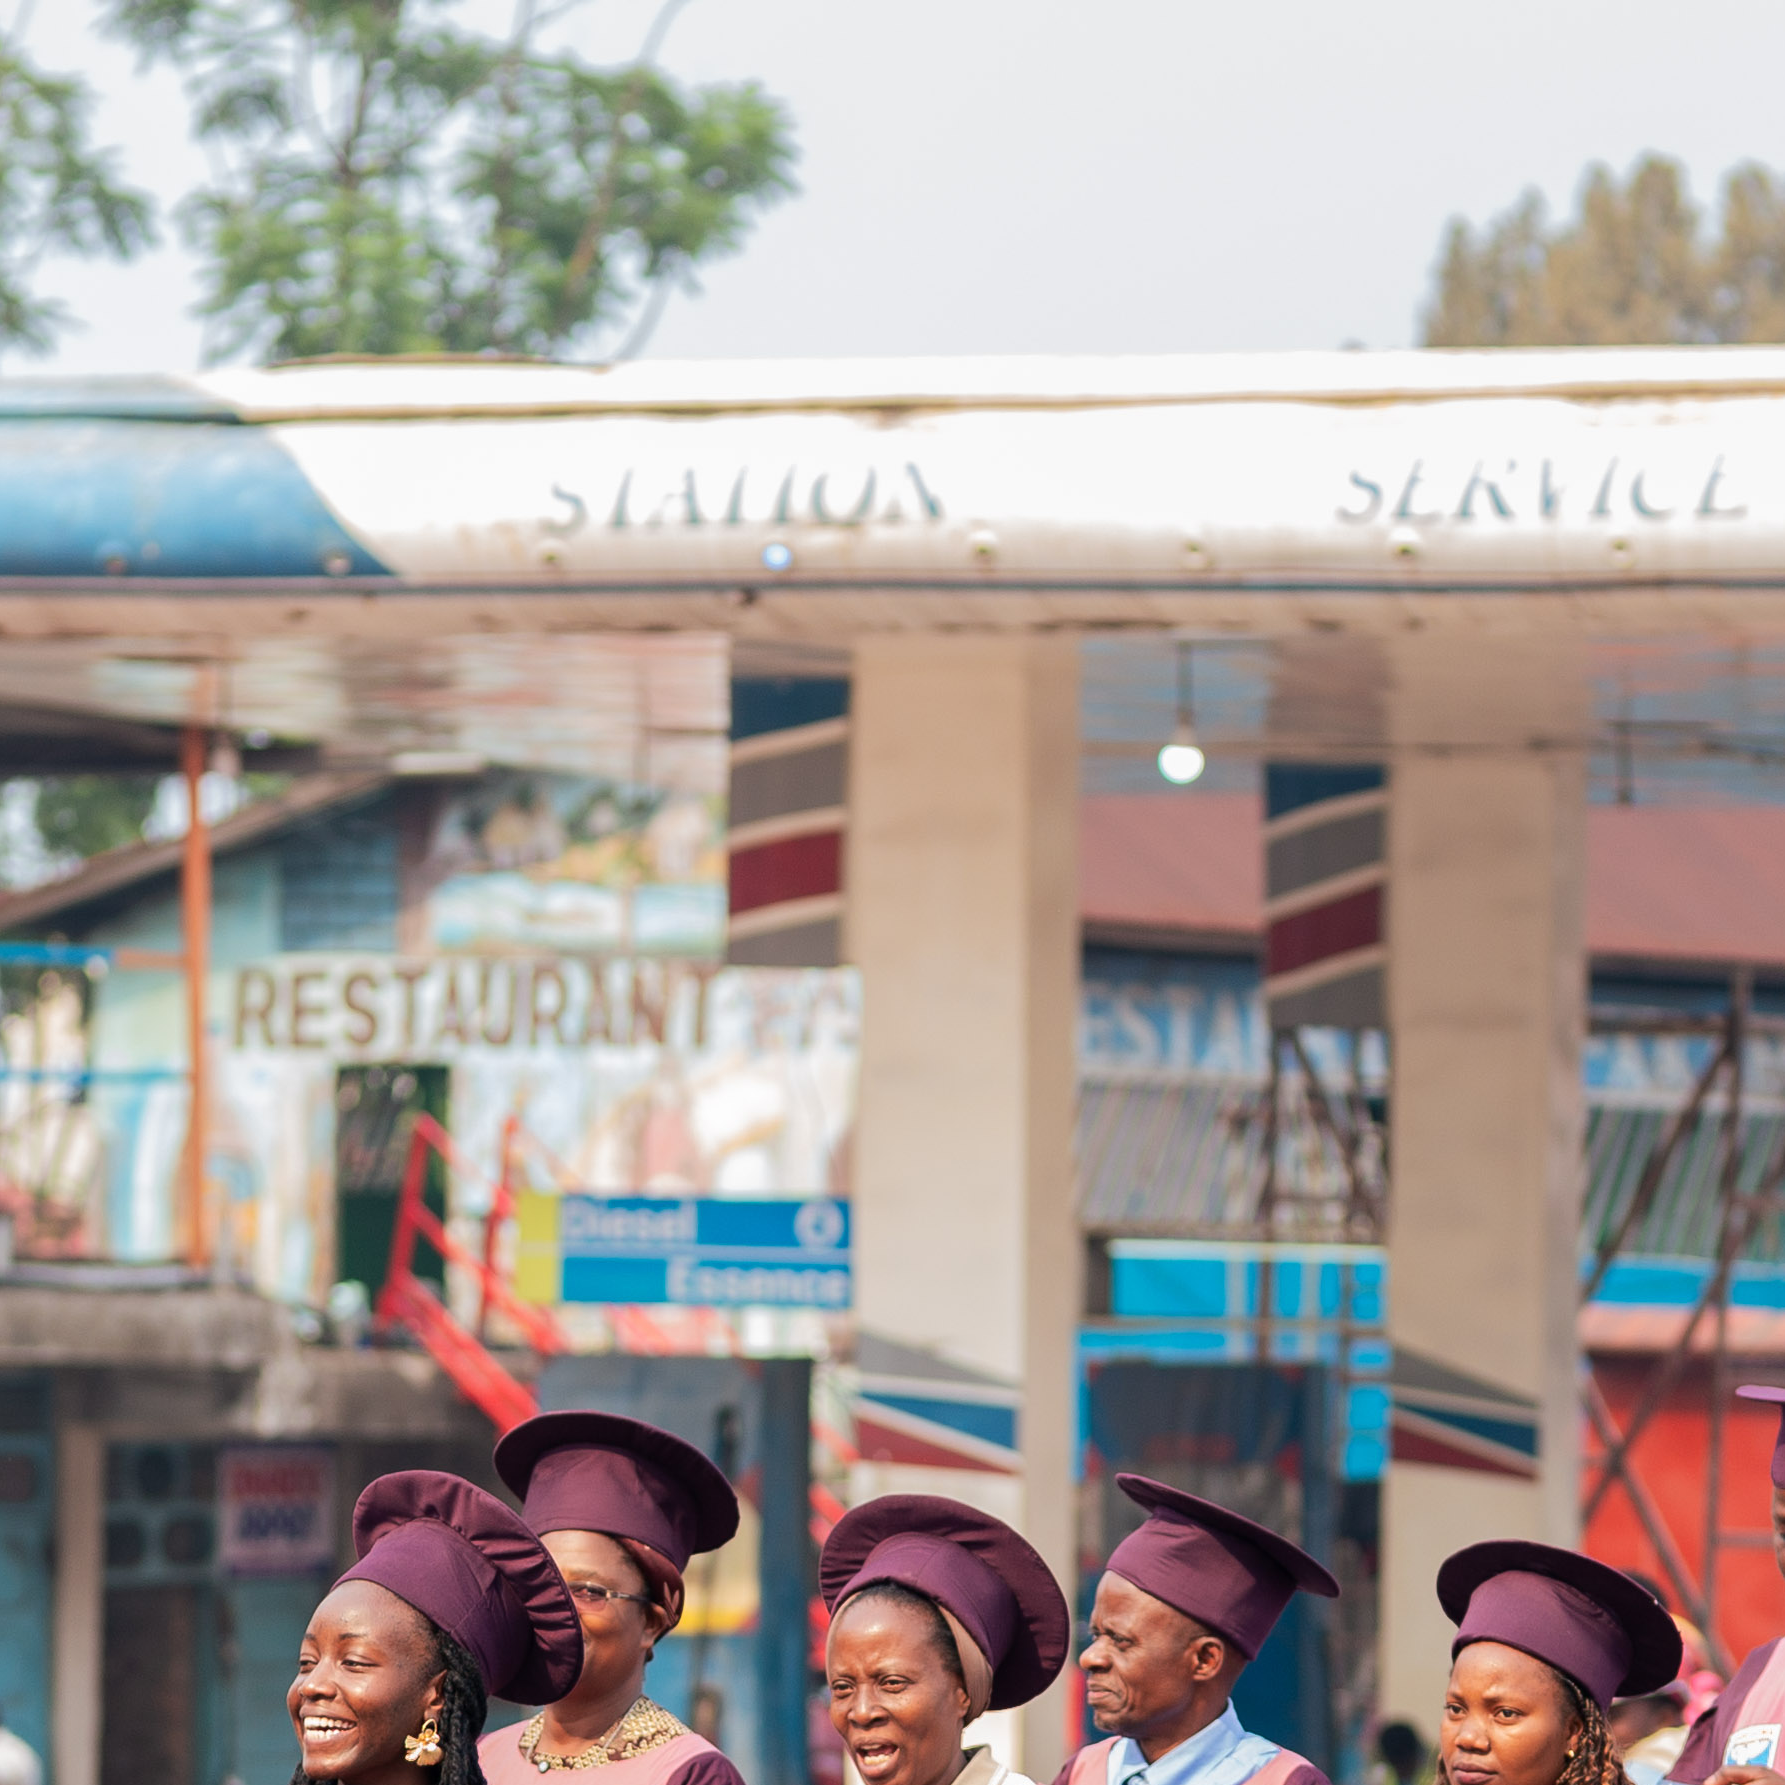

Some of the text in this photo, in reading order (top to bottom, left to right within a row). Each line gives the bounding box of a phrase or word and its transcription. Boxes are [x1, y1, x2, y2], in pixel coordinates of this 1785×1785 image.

[540, 460, 948, 528] STATION
[1333, 455, 1750, 525] SERVICE
[233, 966, 717, 1048] RESTAURANT
